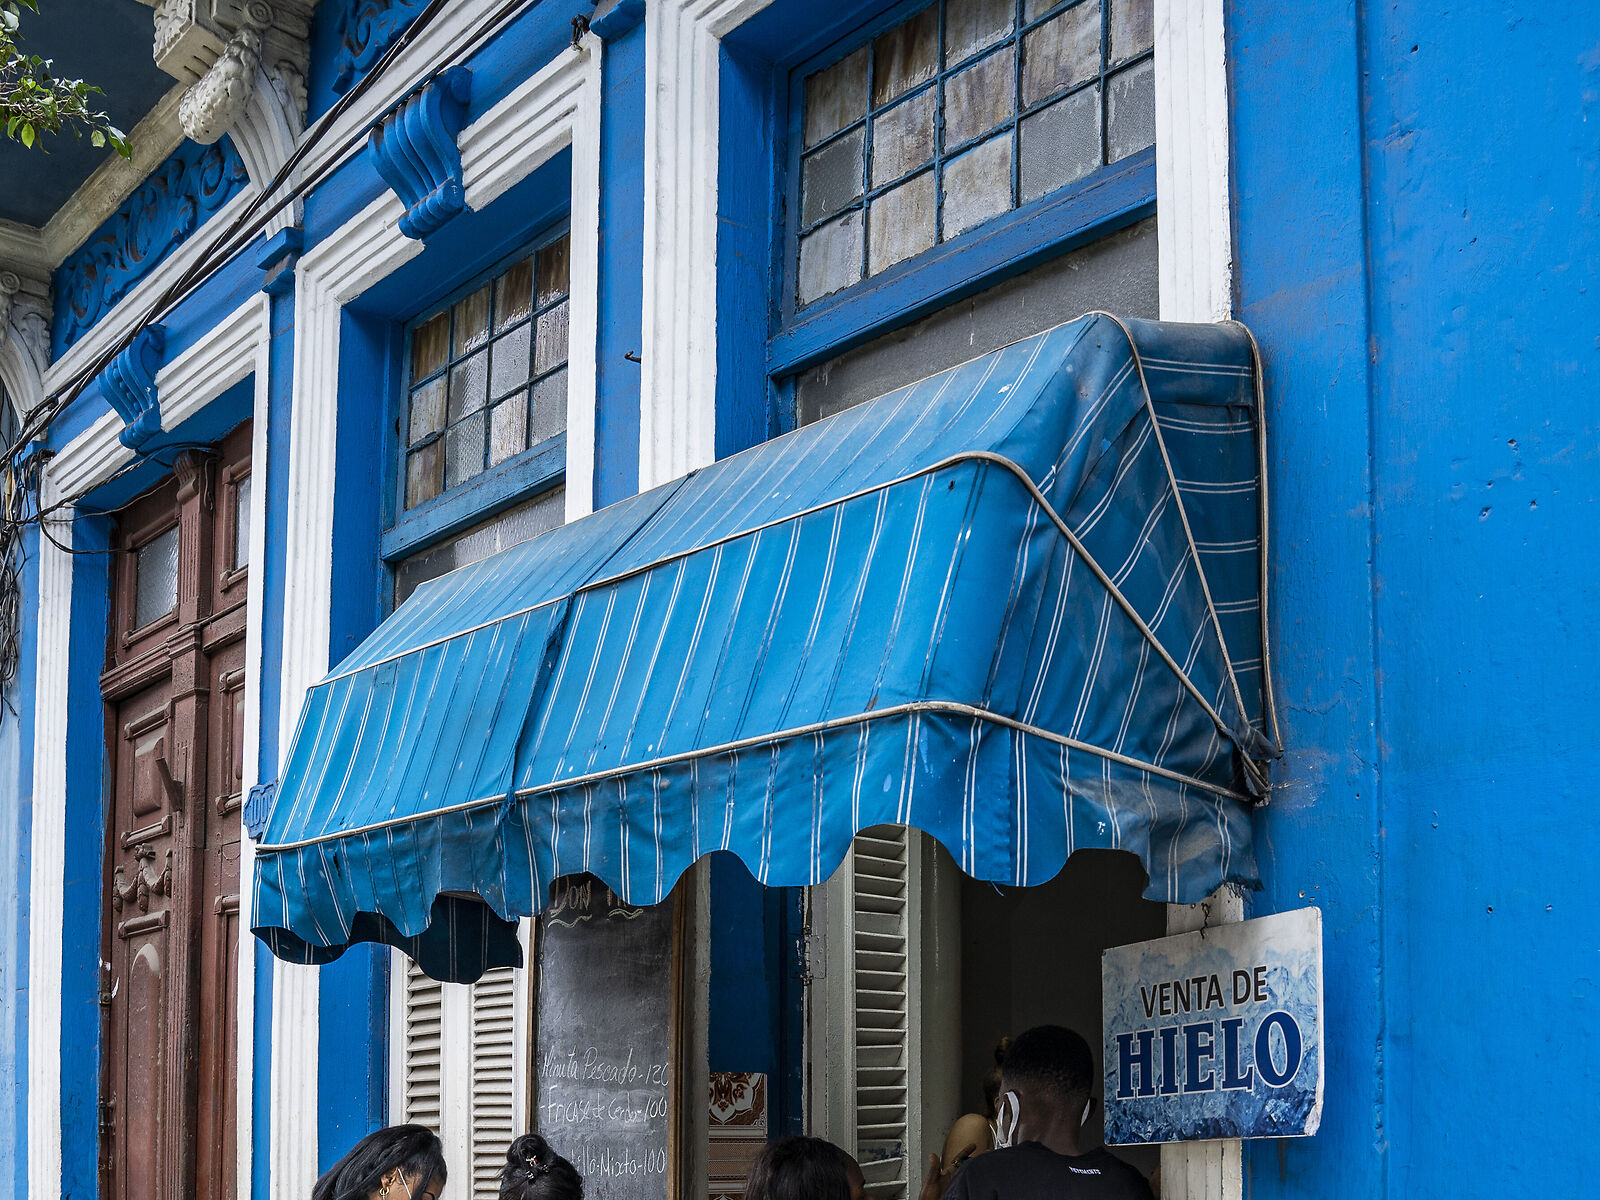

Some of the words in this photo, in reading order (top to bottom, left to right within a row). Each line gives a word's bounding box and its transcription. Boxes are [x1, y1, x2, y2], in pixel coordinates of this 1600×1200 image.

[1140, 973, 1226, 1019] VENTA
[1232, 965, 1268, 1006] DE
[1116, 1009, 1303, 1101] HIELO
